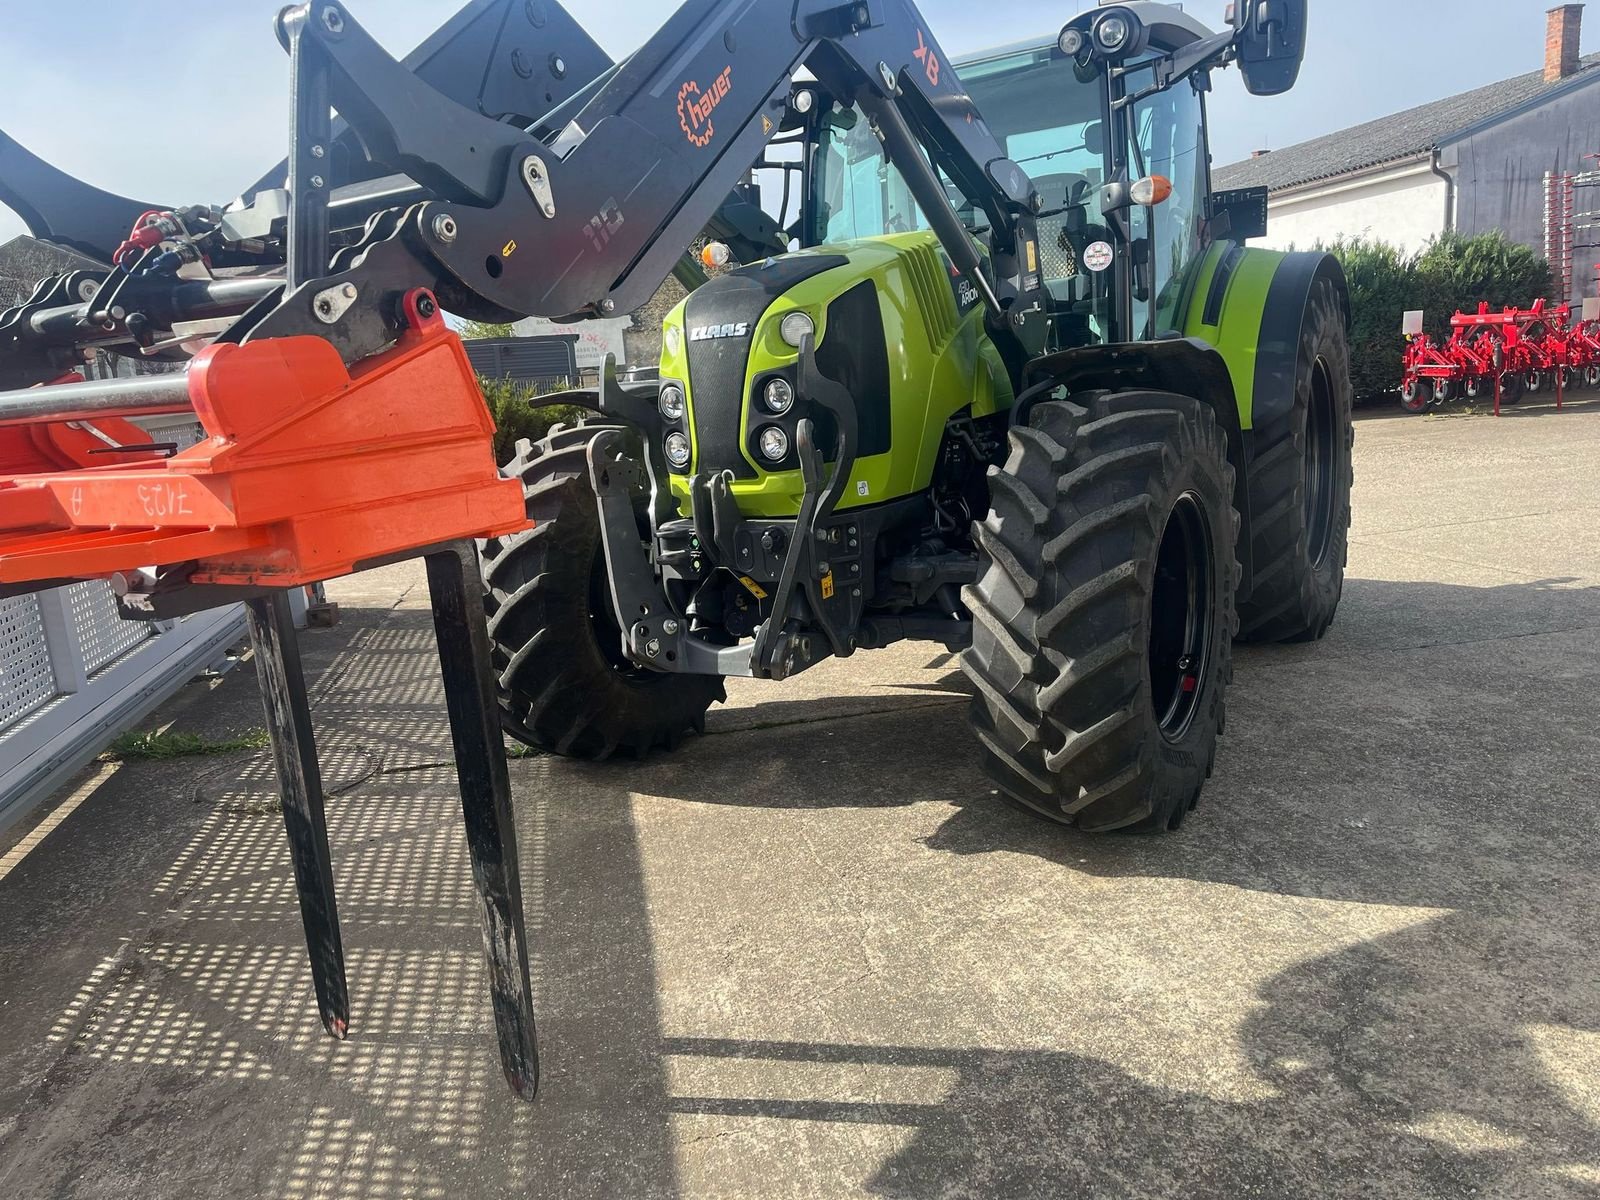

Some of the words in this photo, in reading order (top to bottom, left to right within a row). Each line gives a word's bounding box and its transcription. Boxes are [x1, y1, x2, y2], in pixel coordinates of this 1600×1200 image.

[912, 27, 940, 87] XB
[686, 64, 732, 130] hauer
[961, 287, 979, 307] ARION
[690, 322, 749, 341] CLAAS
[137, 481, 193, 517] 7123
